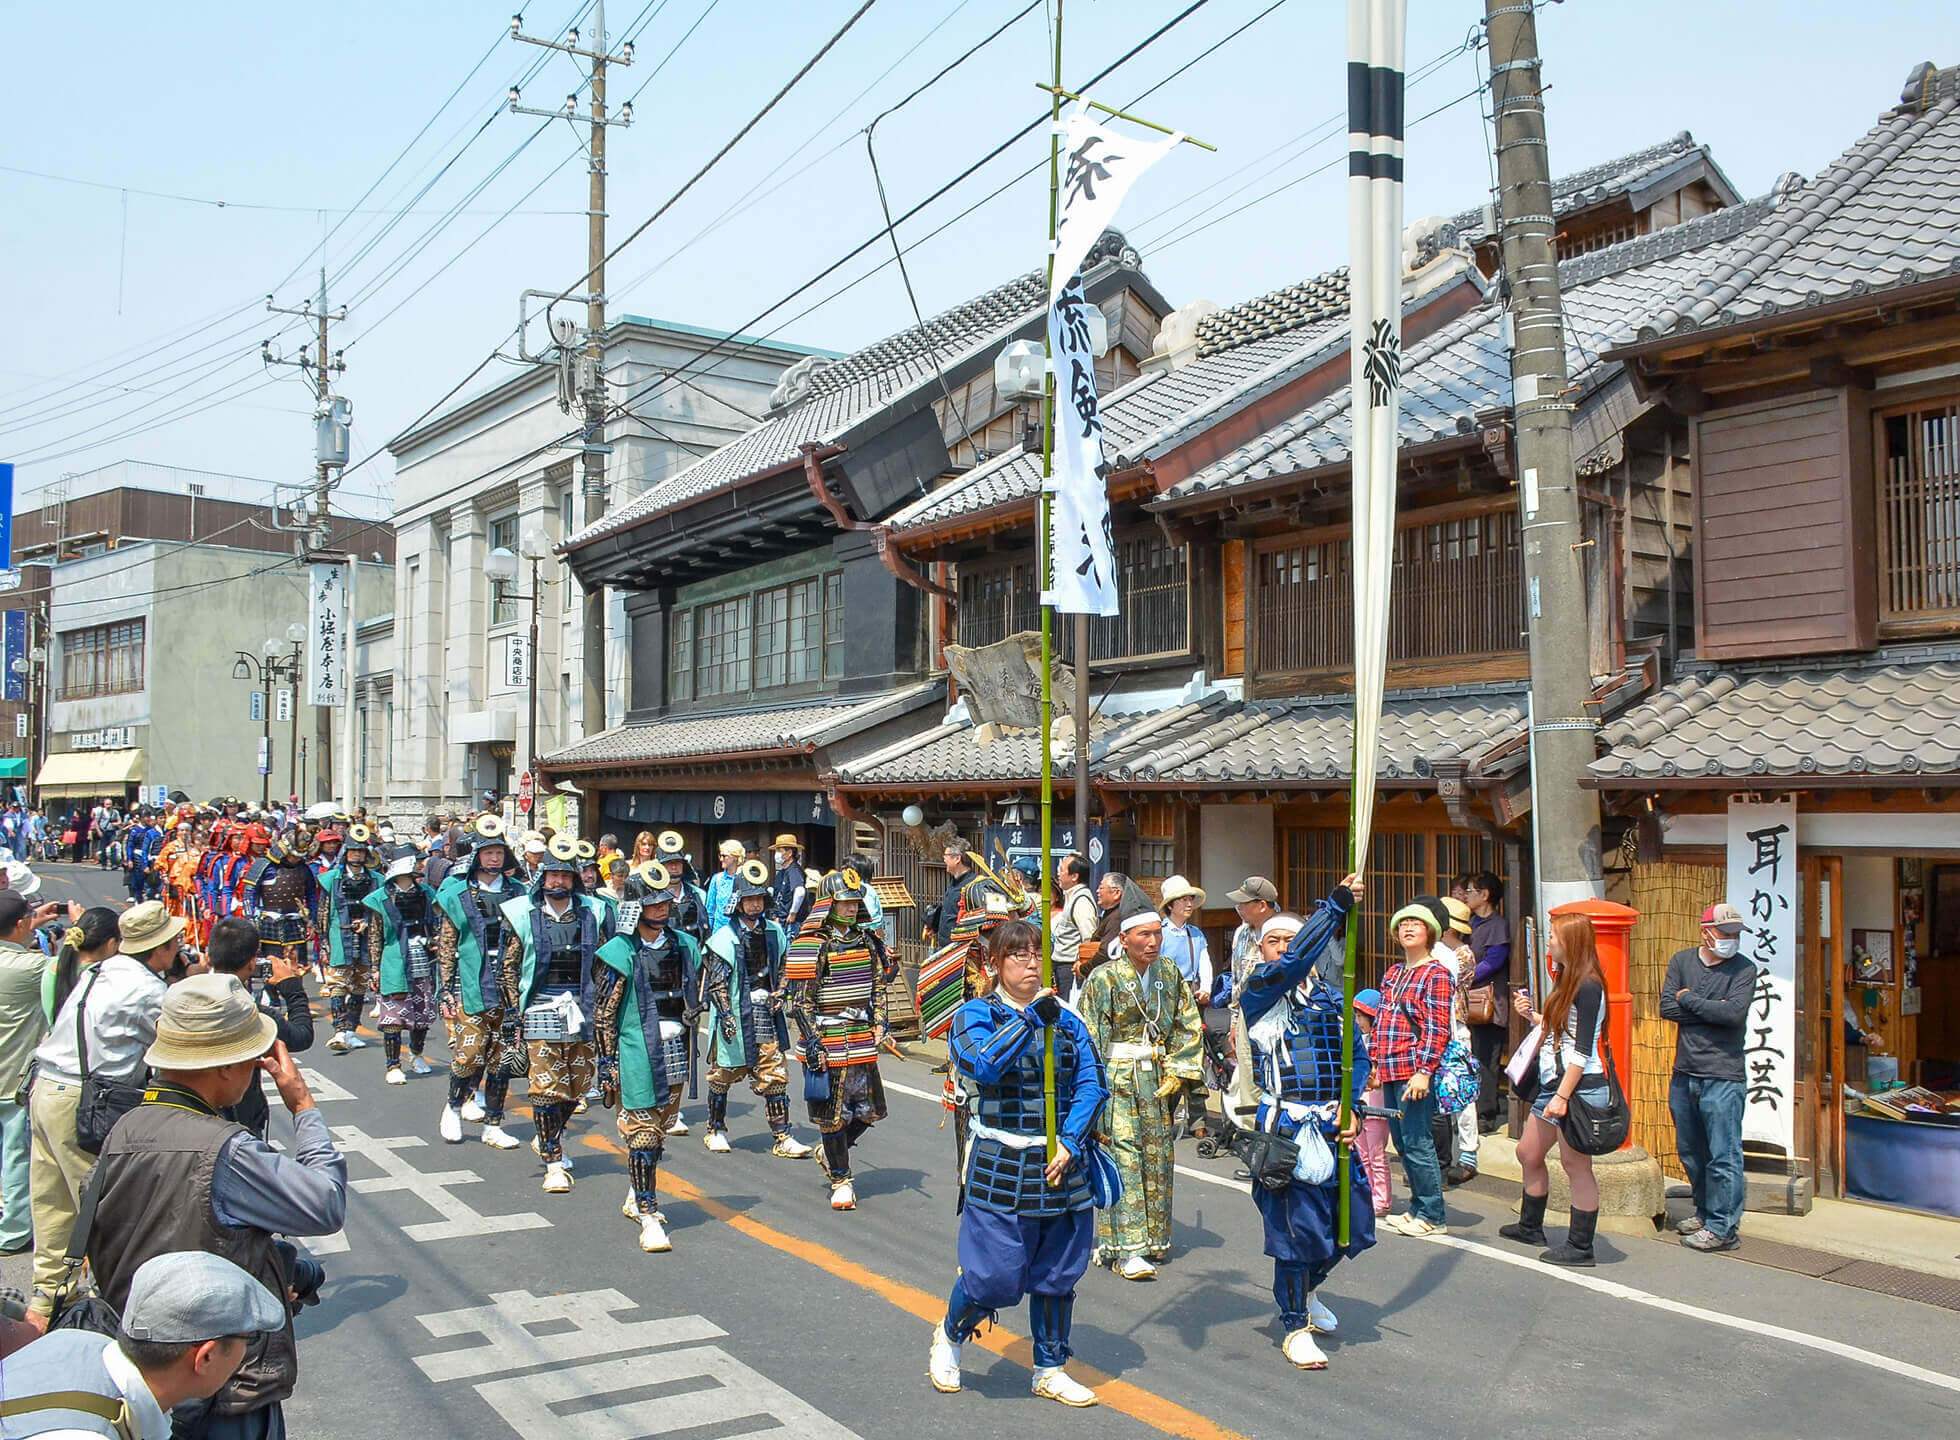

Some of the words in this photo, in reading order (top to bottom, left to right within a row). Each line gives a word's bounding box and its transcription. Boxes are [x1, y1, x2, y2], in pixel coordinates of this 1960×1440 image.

[319, 607, 337, 689] 小堀屋本店
[512, 638, 523, 685] 中央商店街
[1744, 824, 1790, 1112] 耳かき手工芸
